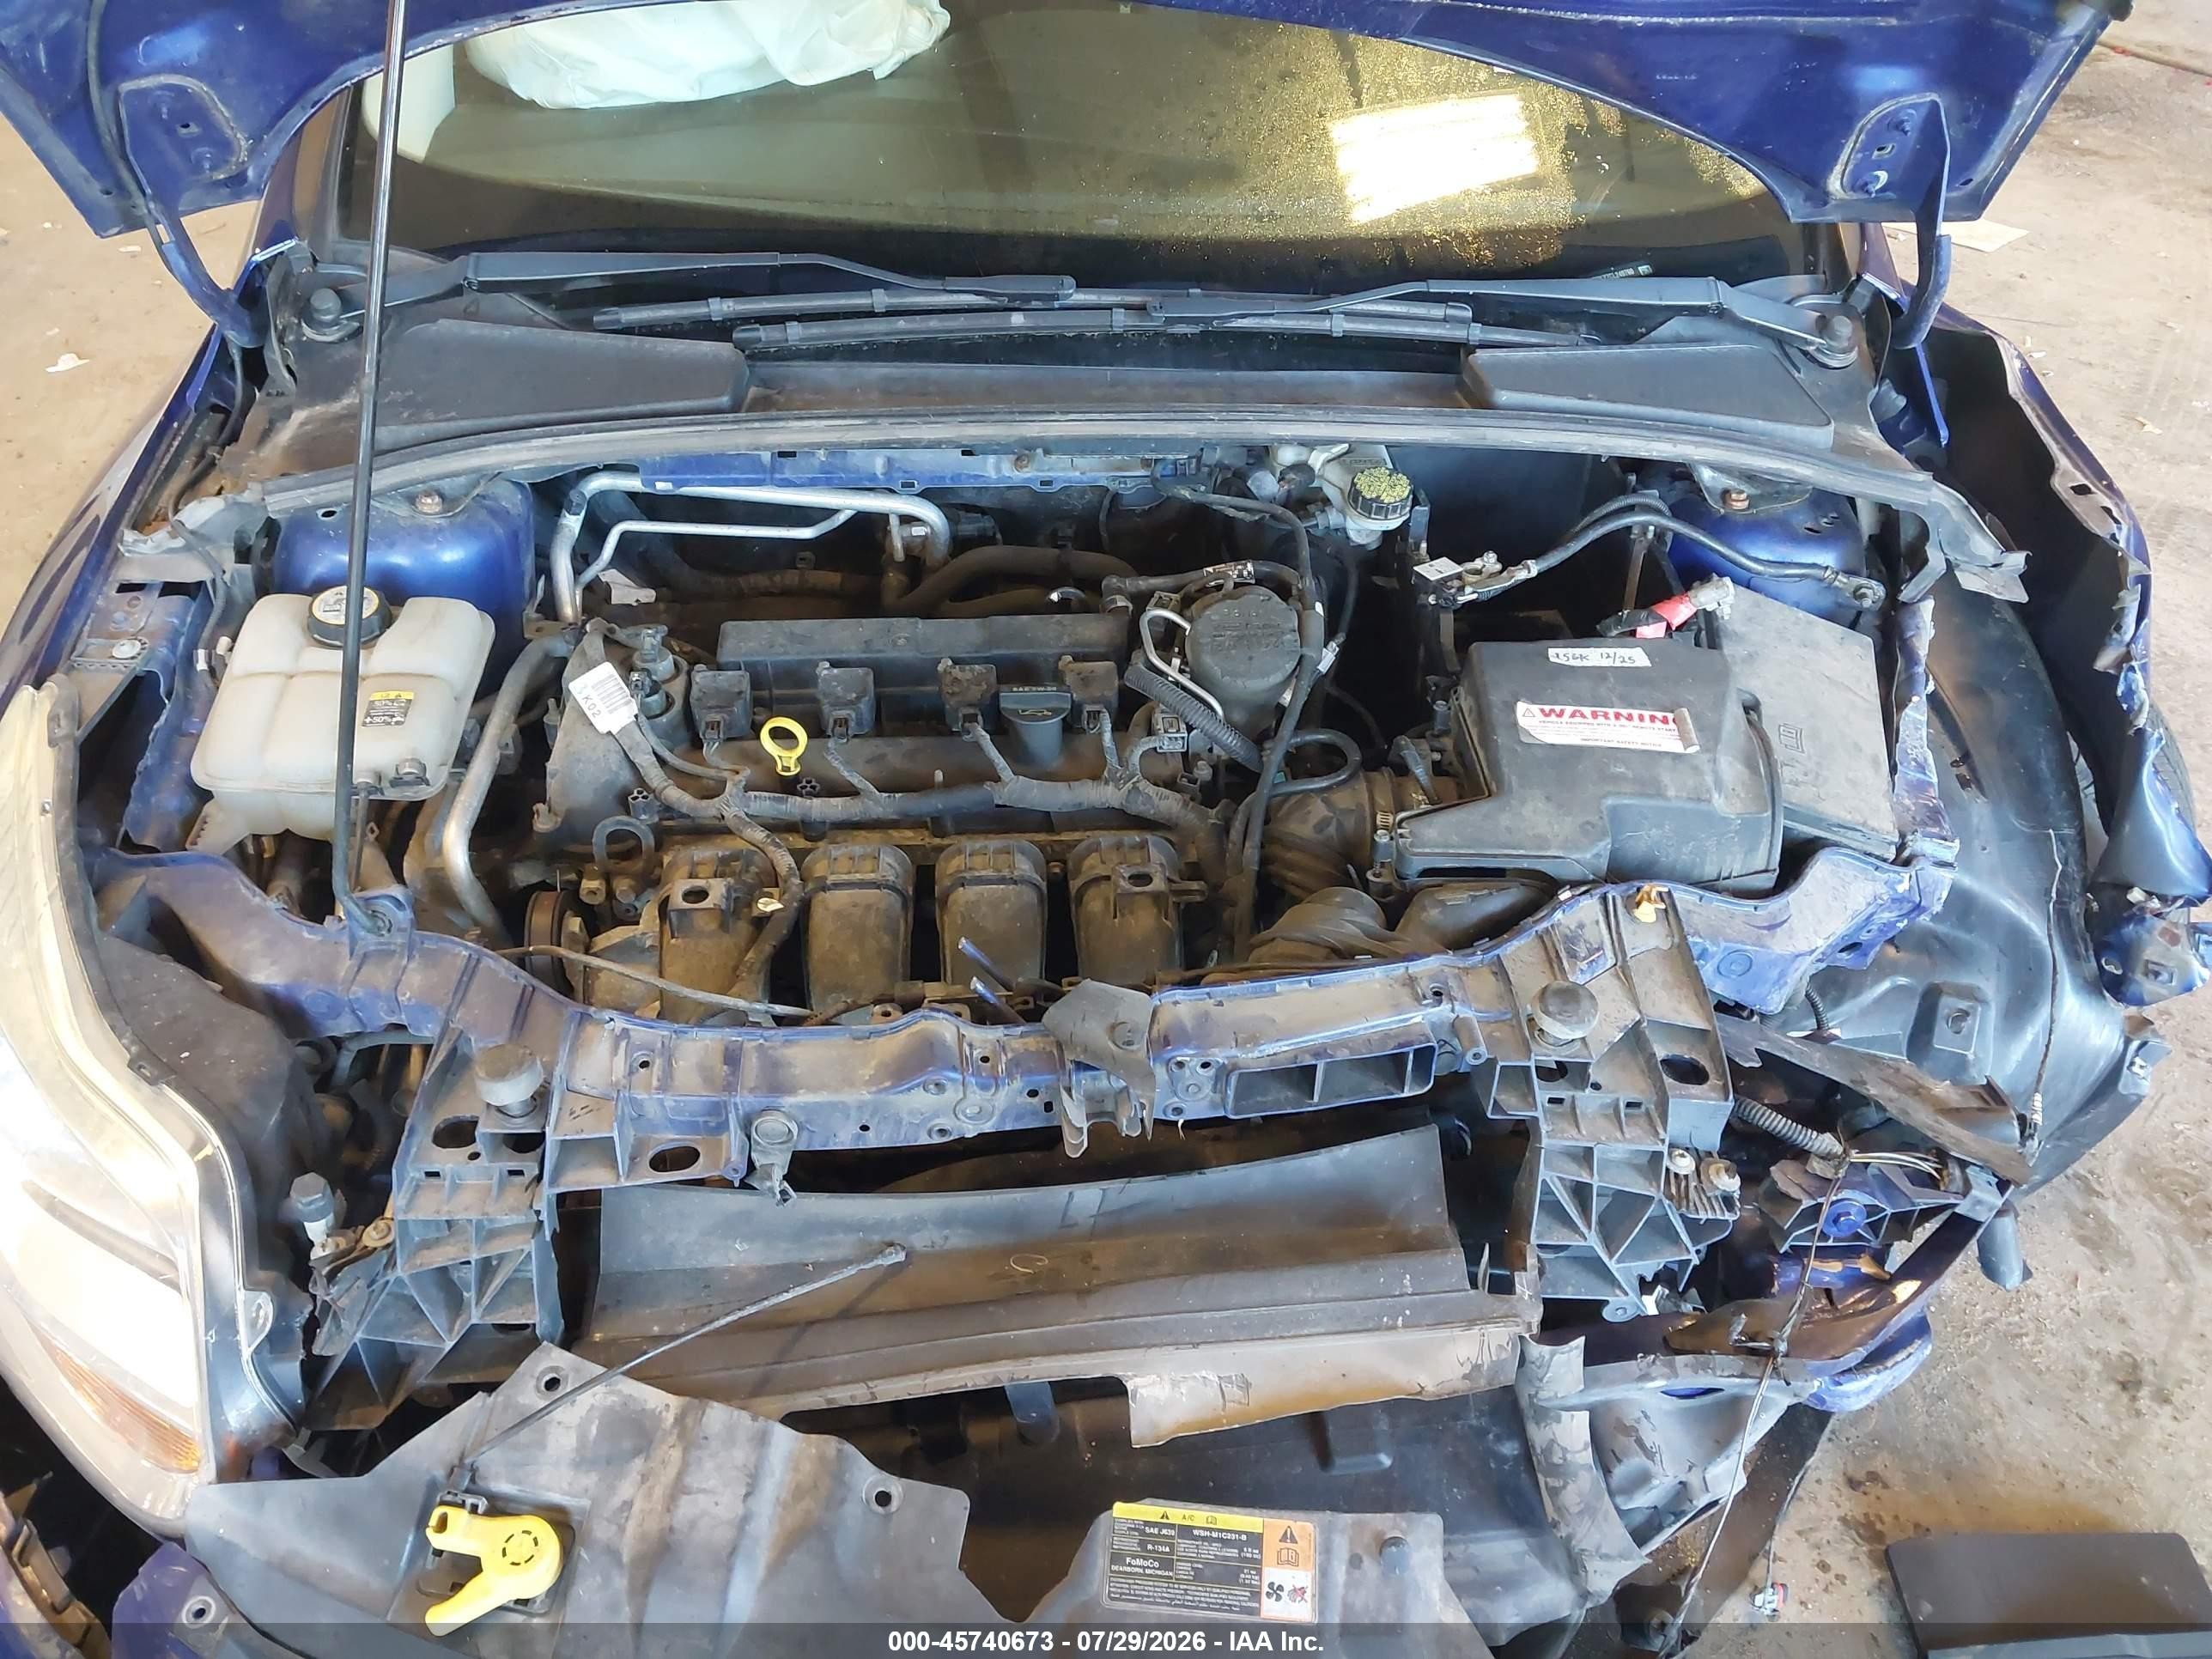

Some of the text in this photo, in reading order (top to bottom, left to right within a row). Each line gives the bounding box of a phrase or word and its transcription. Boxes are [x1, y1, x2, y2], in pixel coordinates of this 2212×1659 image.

[1601, 652, 1636, 665] 12/25
[581, 694, 602, 719] K02
[1145, 1526, 1159, 1534] SAE
[1146, 1543, 1170, 1553] R-134A
[1126, 1557, 1160, 1568] FoMoCo
[1145, 1568, 1174, 1577] MICHIGAN
